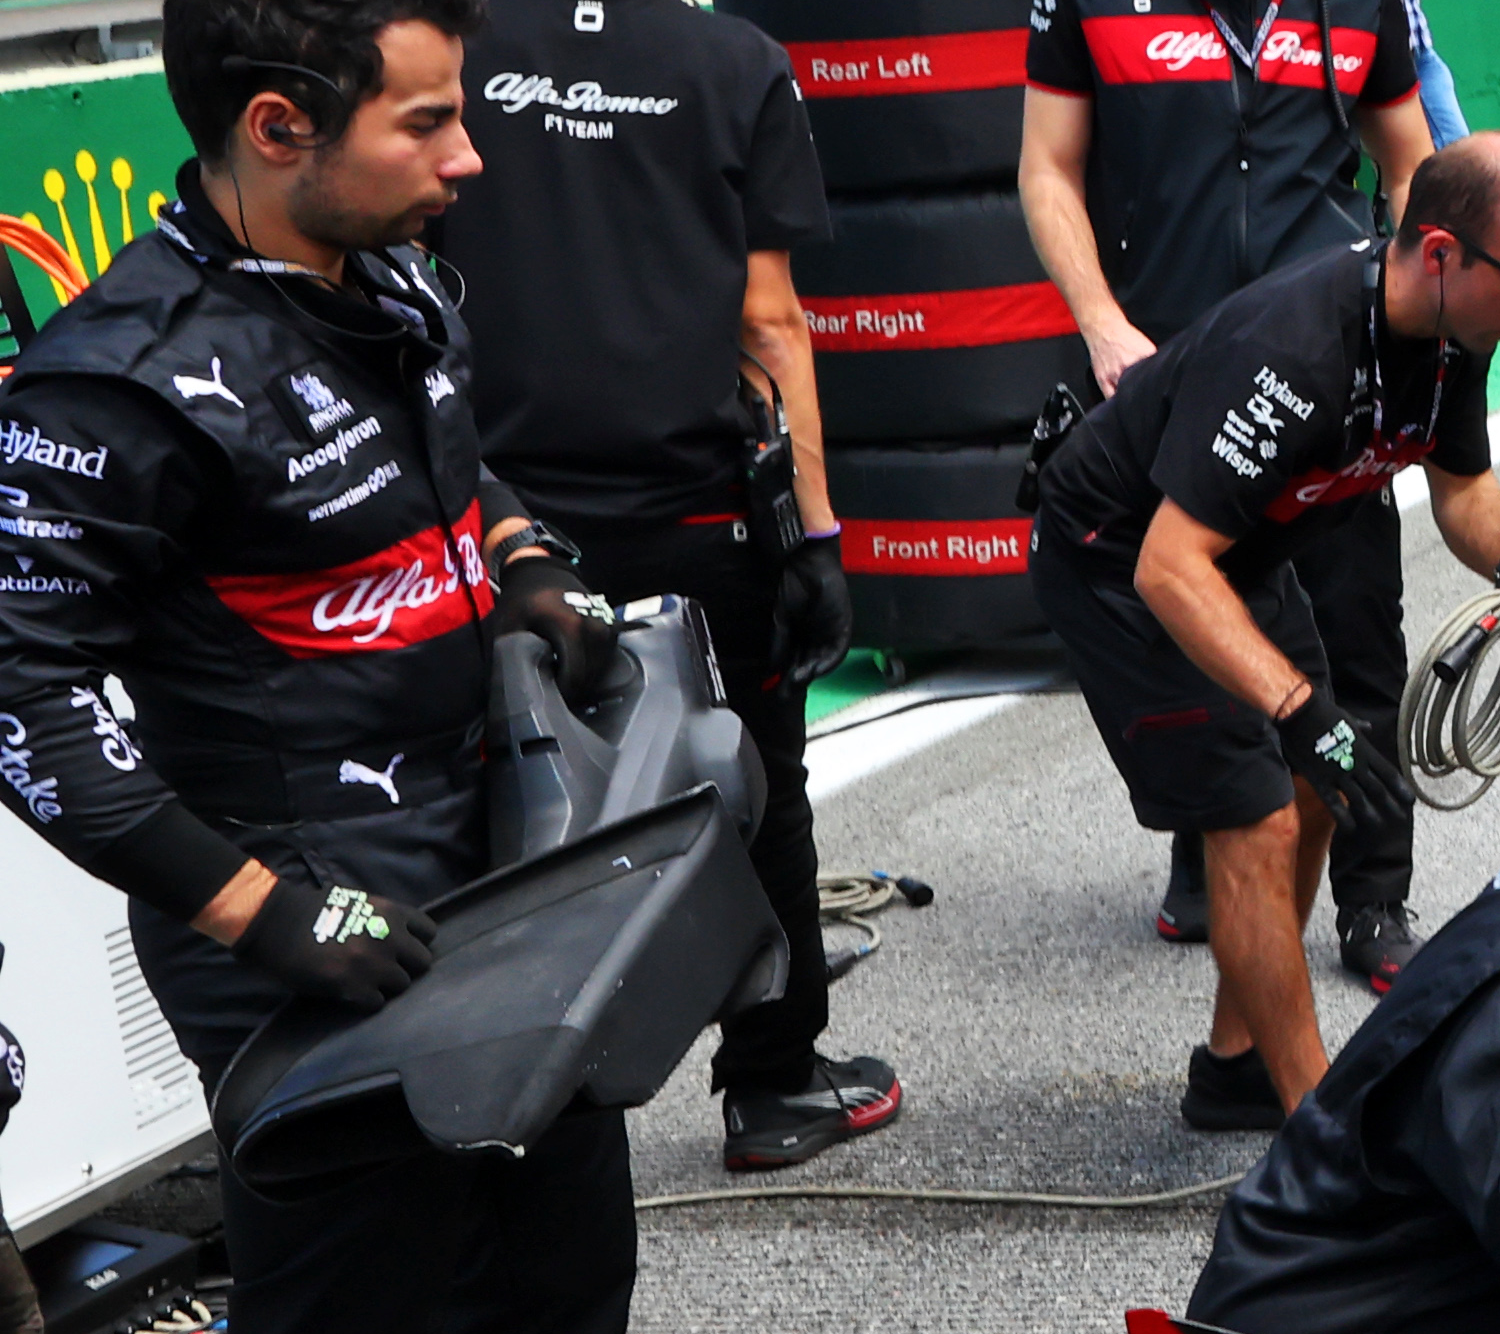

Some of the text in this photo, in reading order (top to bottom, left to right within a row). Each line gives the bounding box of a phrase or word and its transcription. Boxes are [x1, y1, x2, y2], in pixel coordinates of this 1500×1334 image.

[812, 52, 932, 83] Rear Left
[1146, 30, 1227, 72] Alfa
[484, 72, 678, 116] Alfa Romeo
[544, 114, 613, 140] F1 TEAM
[803, 308, 926, 339] Rear Right
[1253, 365, 1315, 422] Hyland
[1211, 433, 1263, 480] Wispr
[872, 535, 1019, 565] Front Right
[312, 558, 444, 644] Alfa
